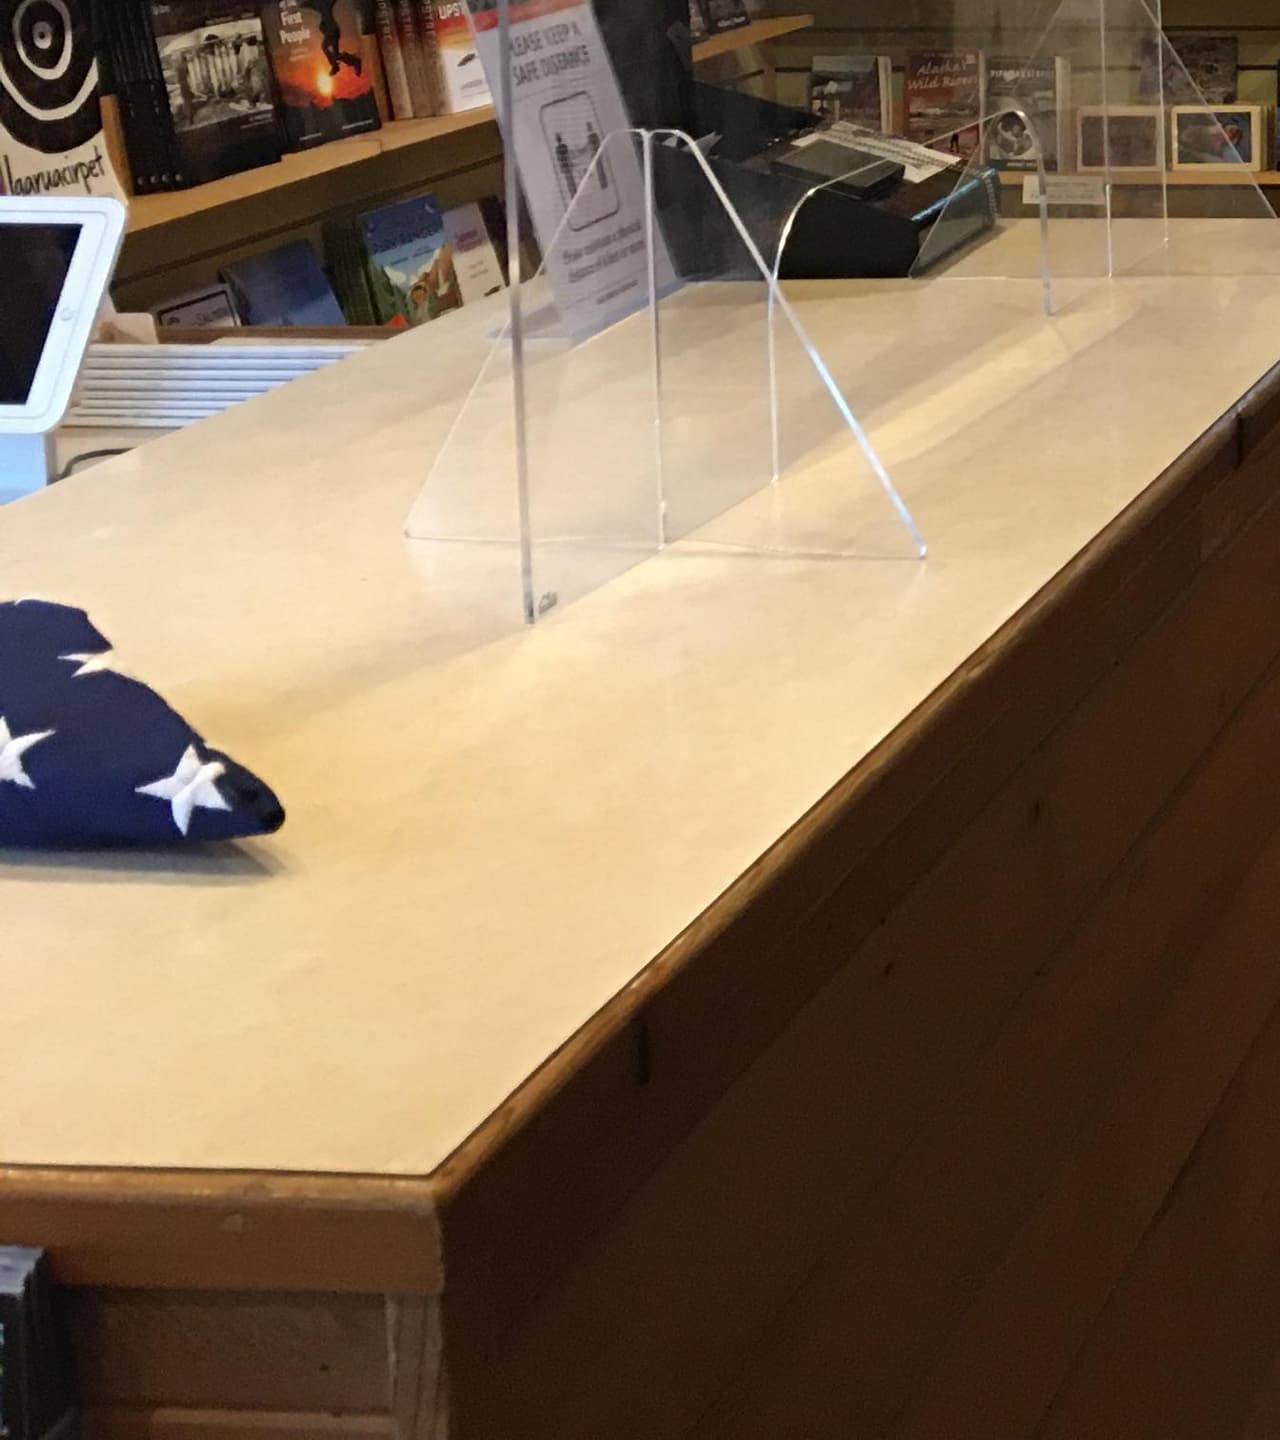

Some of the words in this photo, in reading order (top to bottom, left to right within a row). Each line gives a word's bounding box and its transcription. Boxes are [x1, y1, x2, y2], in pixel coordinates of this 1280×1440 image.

[281, 11, 303, 27] First
[279, 28, 312, 45] People
[511, 62, 541, 87] SAFE
[542, 45, 590, 76] DISTANCE
[908, 77, 940, 90] Wild
